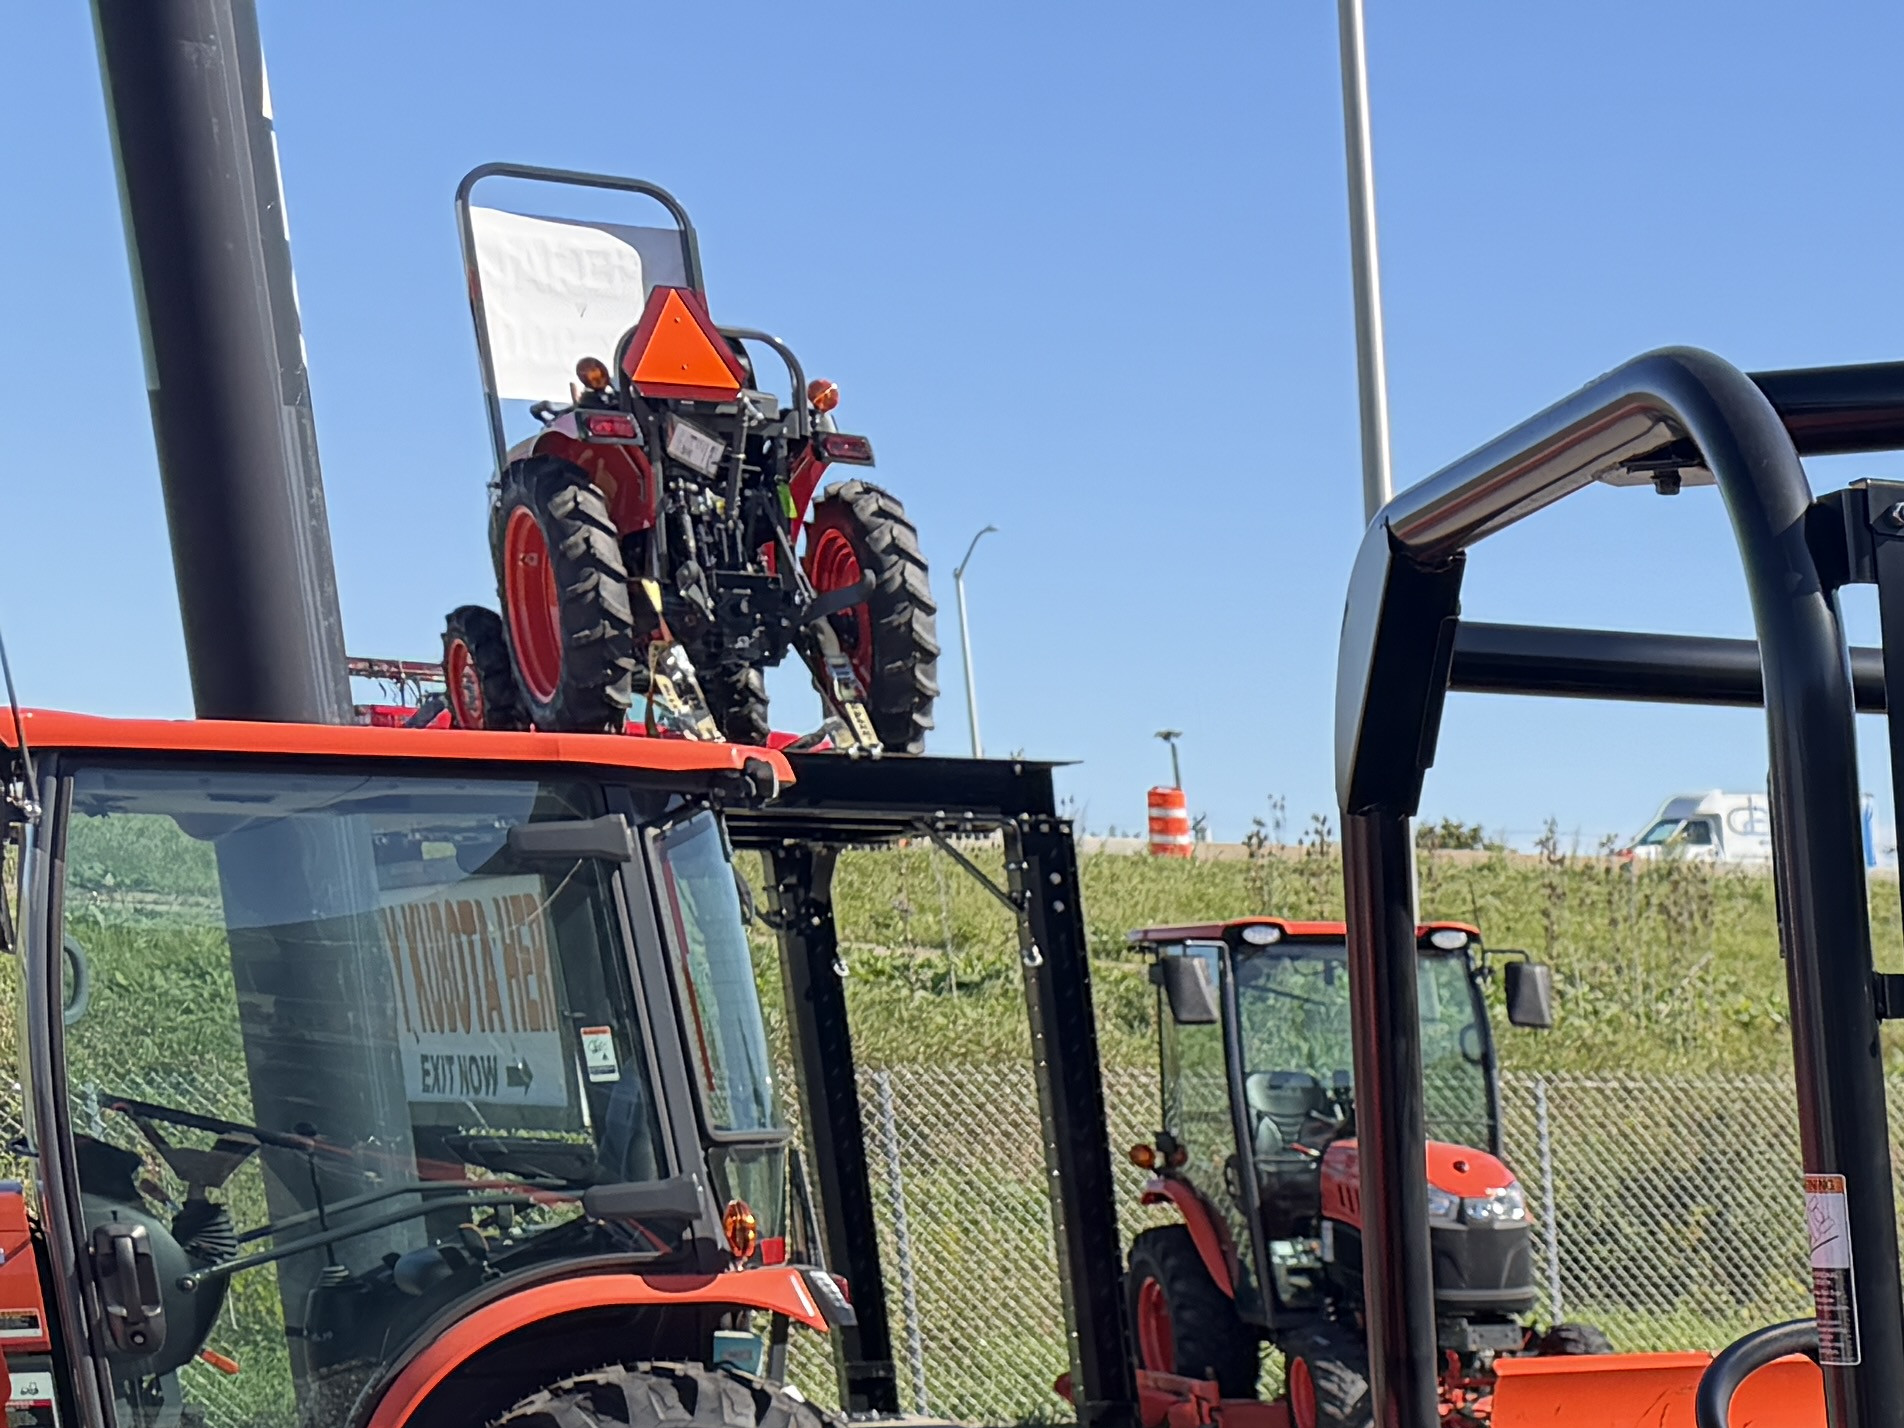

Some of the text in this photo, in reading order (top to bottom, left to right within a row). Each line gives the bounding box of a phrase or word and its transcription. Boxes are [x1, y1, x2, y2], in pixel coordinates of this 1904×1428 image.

[401, 898, 506, 1035] KUBOTA
[419, 1053, 499, 1097] EXIT NOW
